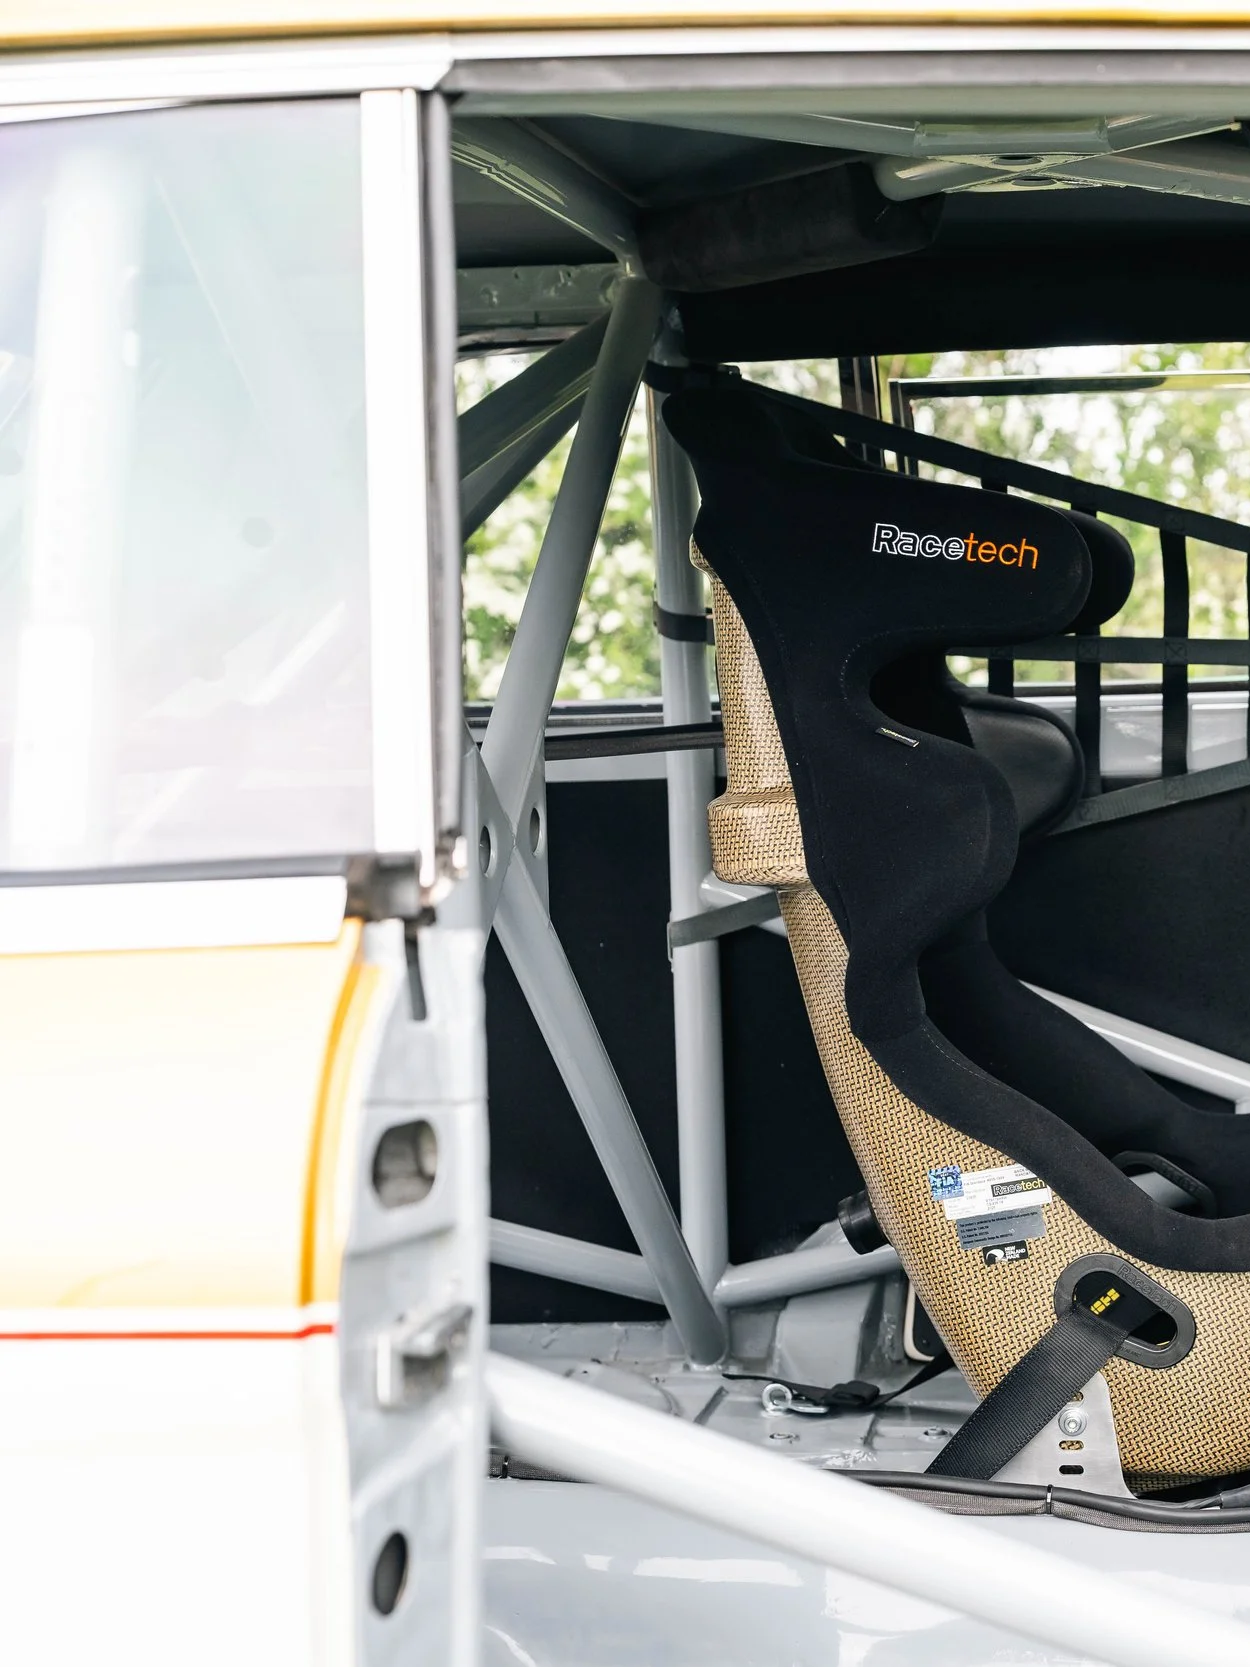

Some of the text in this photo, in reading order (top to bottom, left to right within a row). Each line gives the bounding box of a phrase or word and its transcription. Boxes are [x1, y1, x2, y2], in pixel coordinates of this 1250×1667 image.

[872, 523, 1039, 569] Racetech
[993, 1179, 1045, 1195] Racetech
[1118, 1263, 1178, 1314] Racetech
